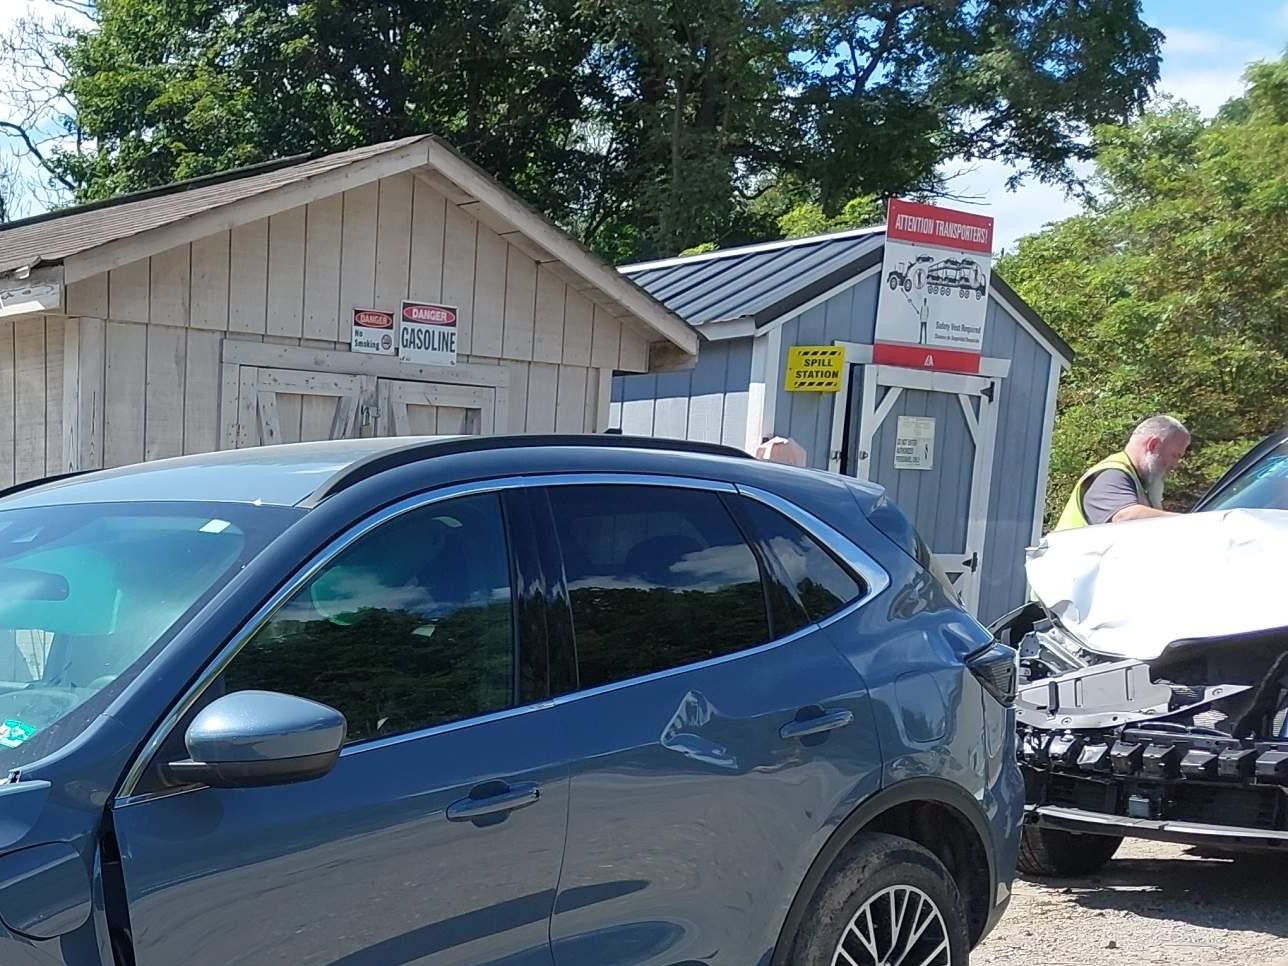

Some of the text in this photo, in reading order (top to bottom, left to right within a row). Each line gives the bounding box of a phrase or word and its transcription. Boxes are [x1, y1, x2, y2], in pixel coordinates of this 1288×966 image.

[895, 214, 988, 243] ATTENTION TRANSPORTERS!
[360, 314, 388, 325] DANGER
[412, 308, 447, 322] DANGER
[354, 329, 363, 337] No
[354, 339, 380, 351] Smoking
[401, 327, 456, 353] GASOLINE
[803, 358, 833, 367] SPILL
[795, 370, 839, 379] STATION
